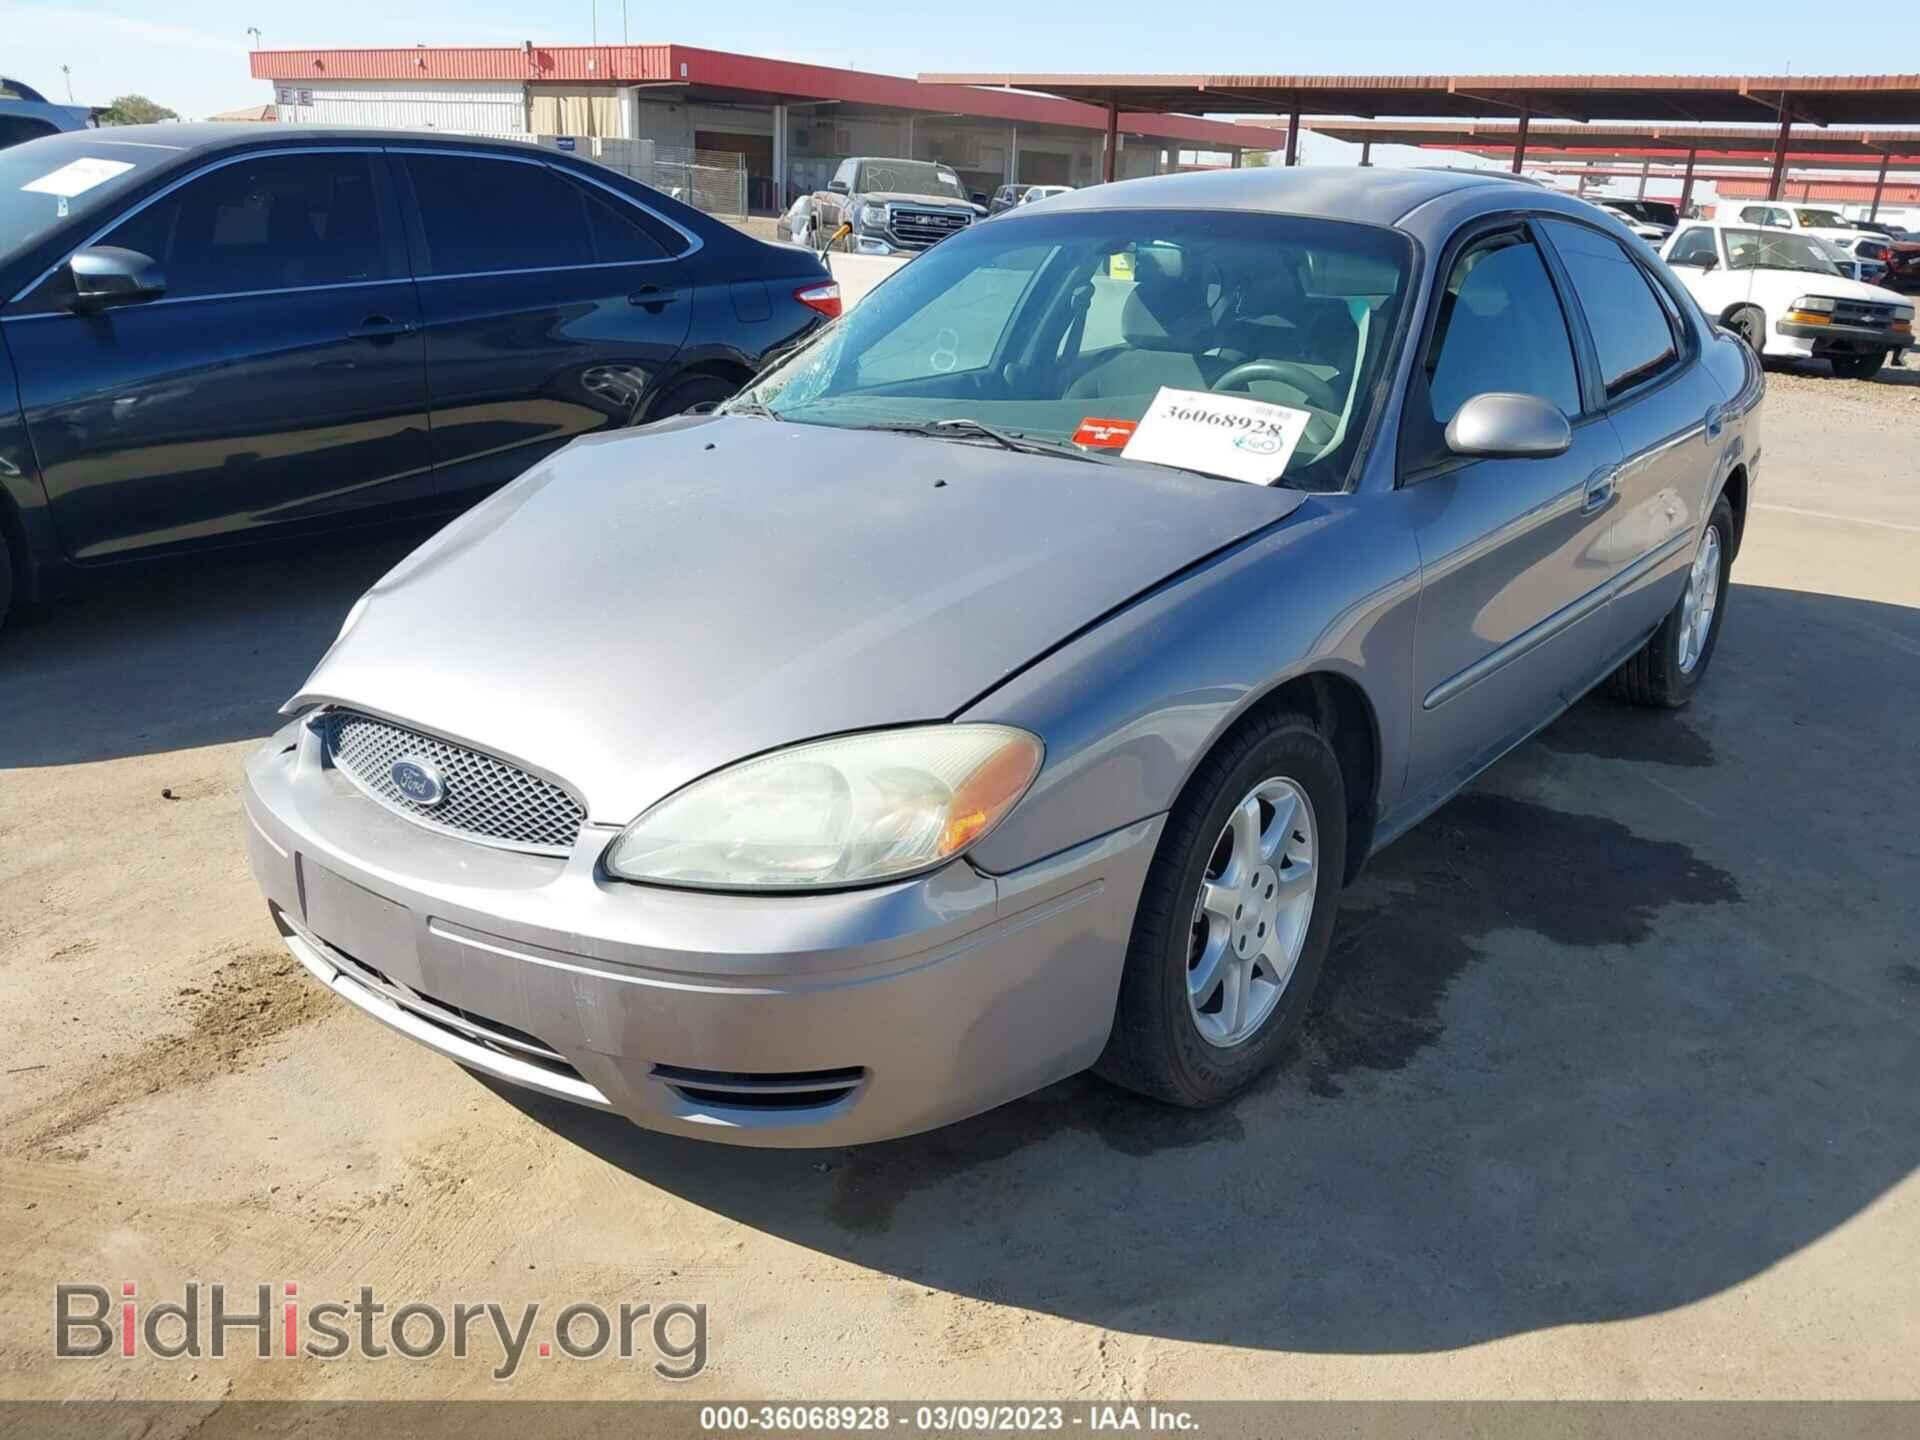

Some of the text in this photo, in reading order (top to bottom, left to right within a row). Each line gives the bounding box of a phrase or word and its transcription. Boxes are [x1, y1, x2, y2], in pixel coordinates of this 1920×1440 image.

[915, 215, 949, 226] GMC
[930, 327, 959, 372] 8
[1162, 405, 1283, 437] 36068928
[400, 767, 426, 794] Ford
